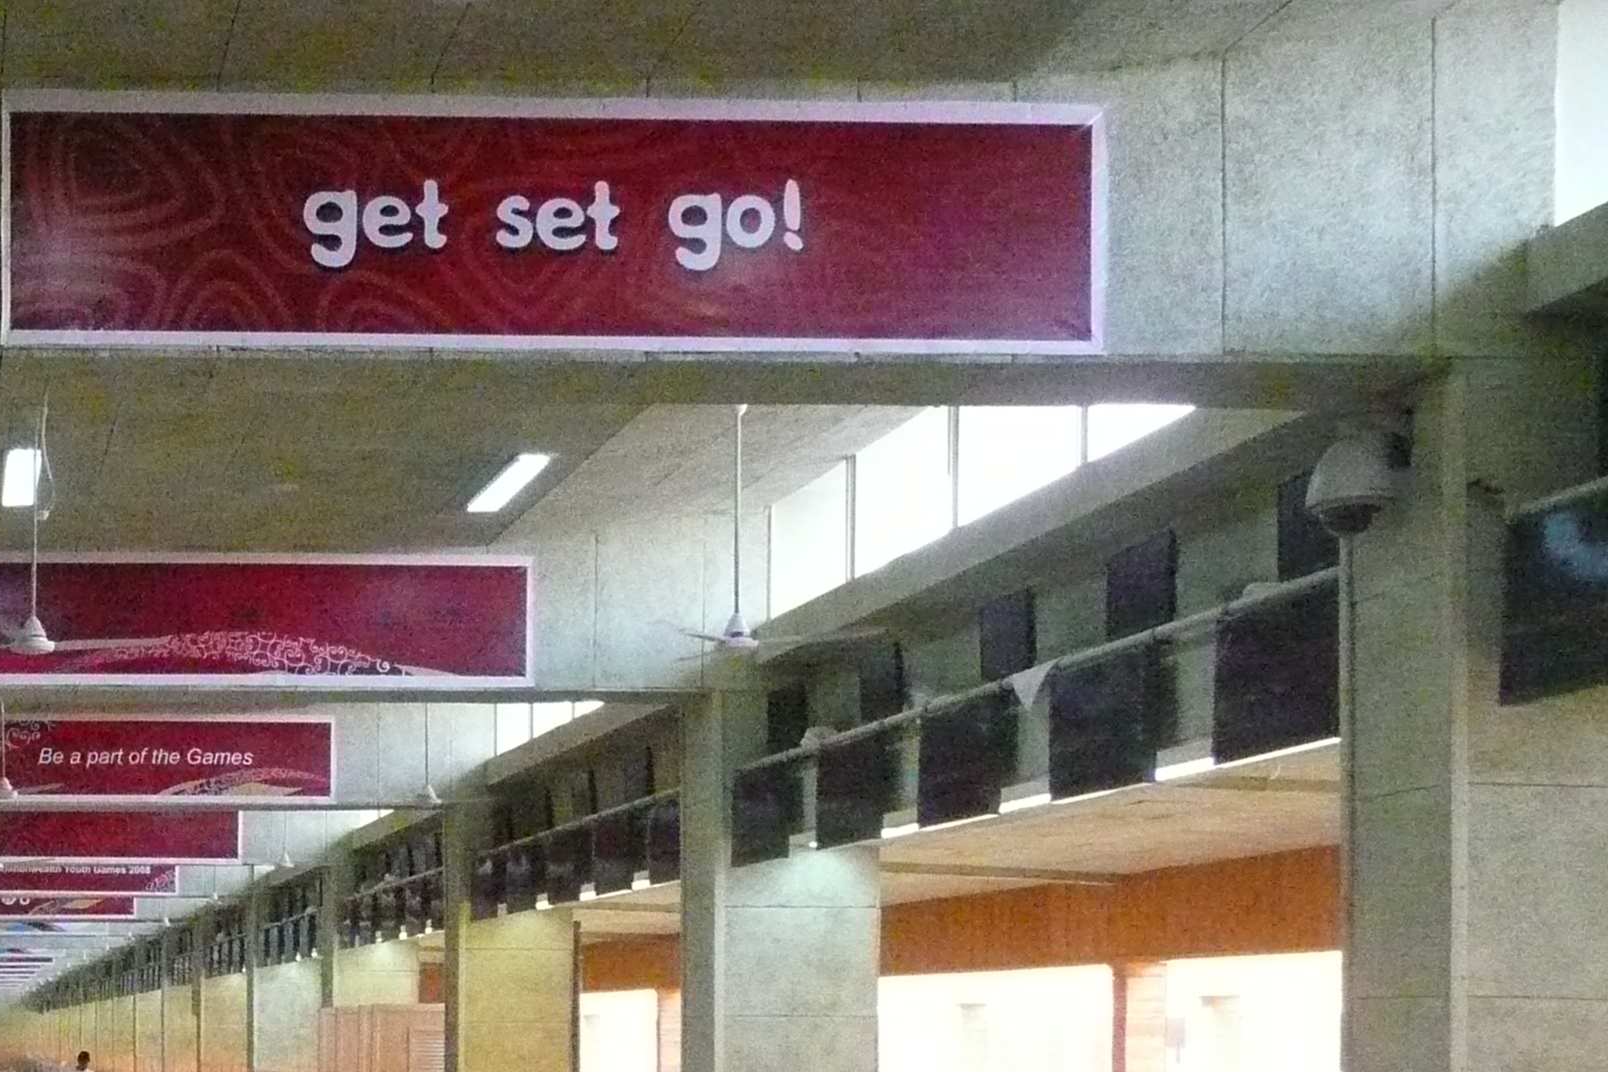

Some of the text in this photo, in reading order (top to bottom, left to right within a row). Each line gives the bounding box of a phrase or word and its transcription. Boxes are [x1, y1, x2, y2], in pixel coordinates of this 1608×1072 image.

[303, 178, 804, 271] get set go!
[37, 747, 254, 768] Be a part of the Games
[93, 866, 127, 875] Games
